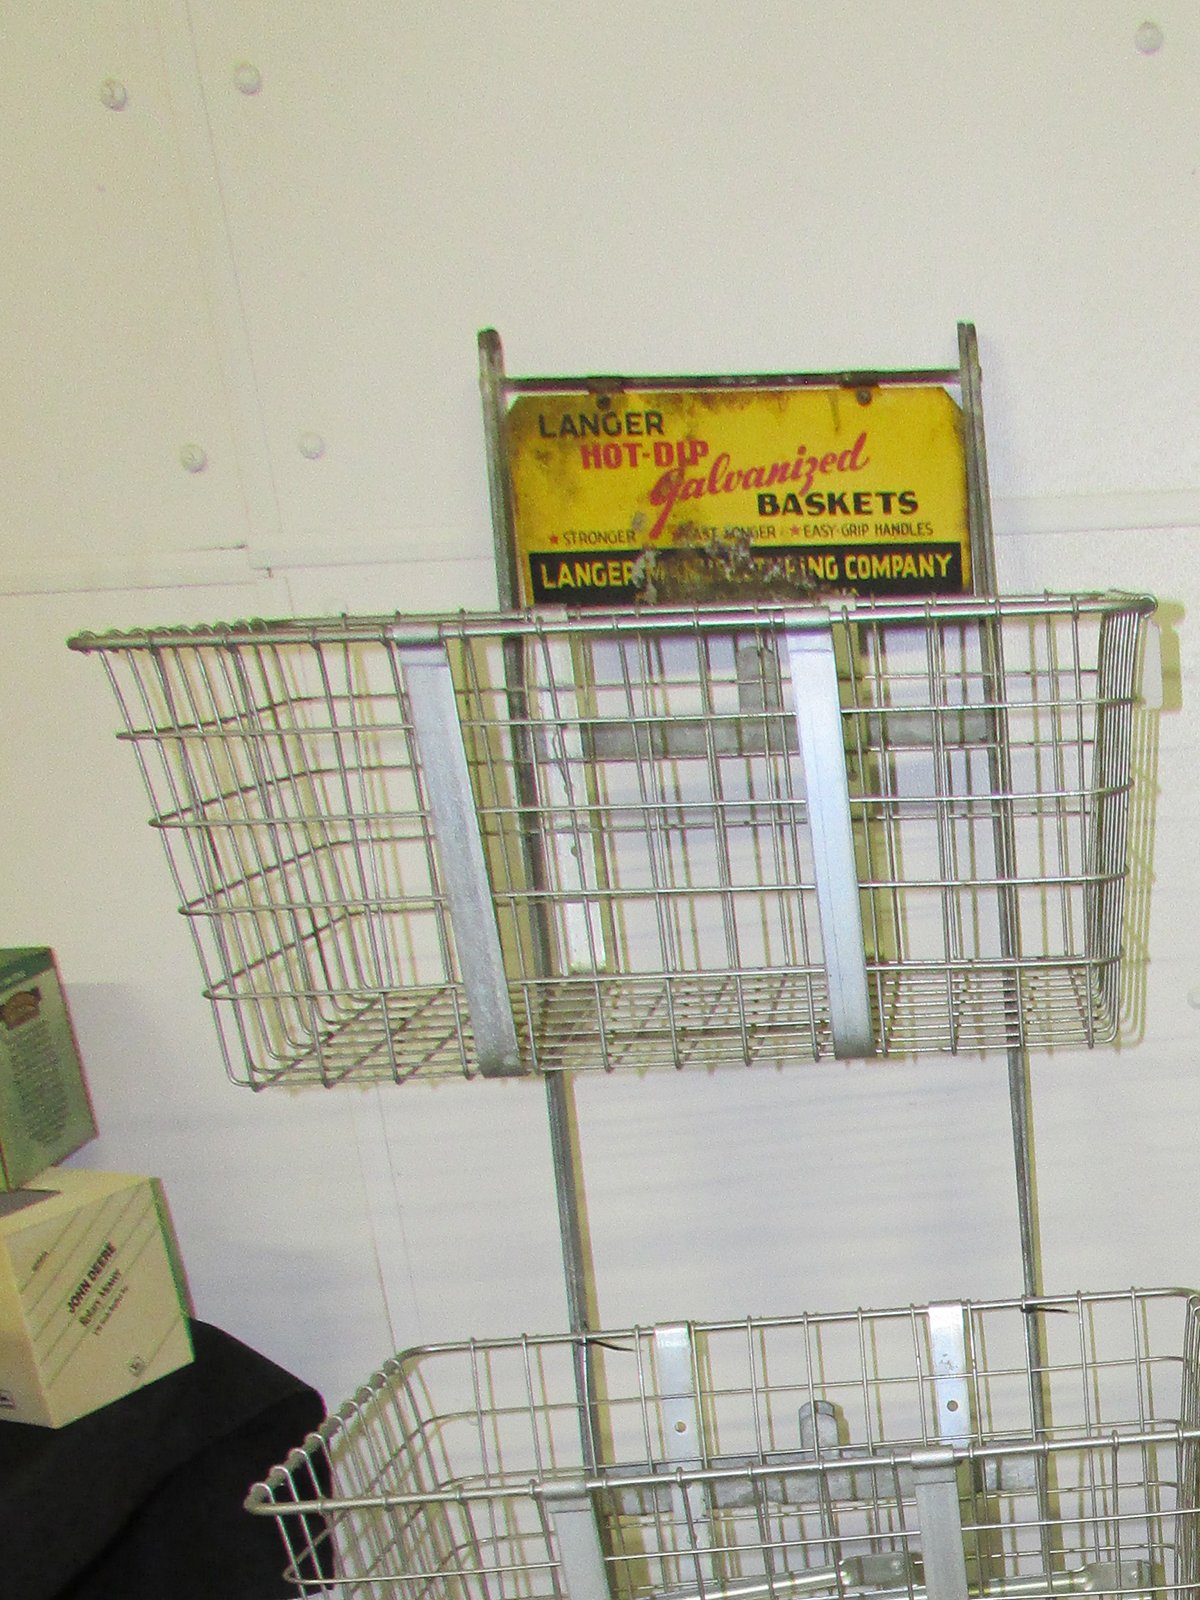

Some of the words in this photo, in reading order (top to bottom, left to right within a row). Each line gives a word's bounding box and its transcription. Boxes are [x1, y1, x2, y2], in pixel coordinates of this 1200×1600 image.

[539, 409, 665, 438] LANGER
[580, 440, 709, 469] HOT-DIP
[648, 431, 870, 541] Galvanized
[757, 490, 919, 517] BASKETS
[563, 529, 636, 546] STRONGER
[875, 521, 934, 537] HANDLES
[845, 552, 953, 580] COMPANY
